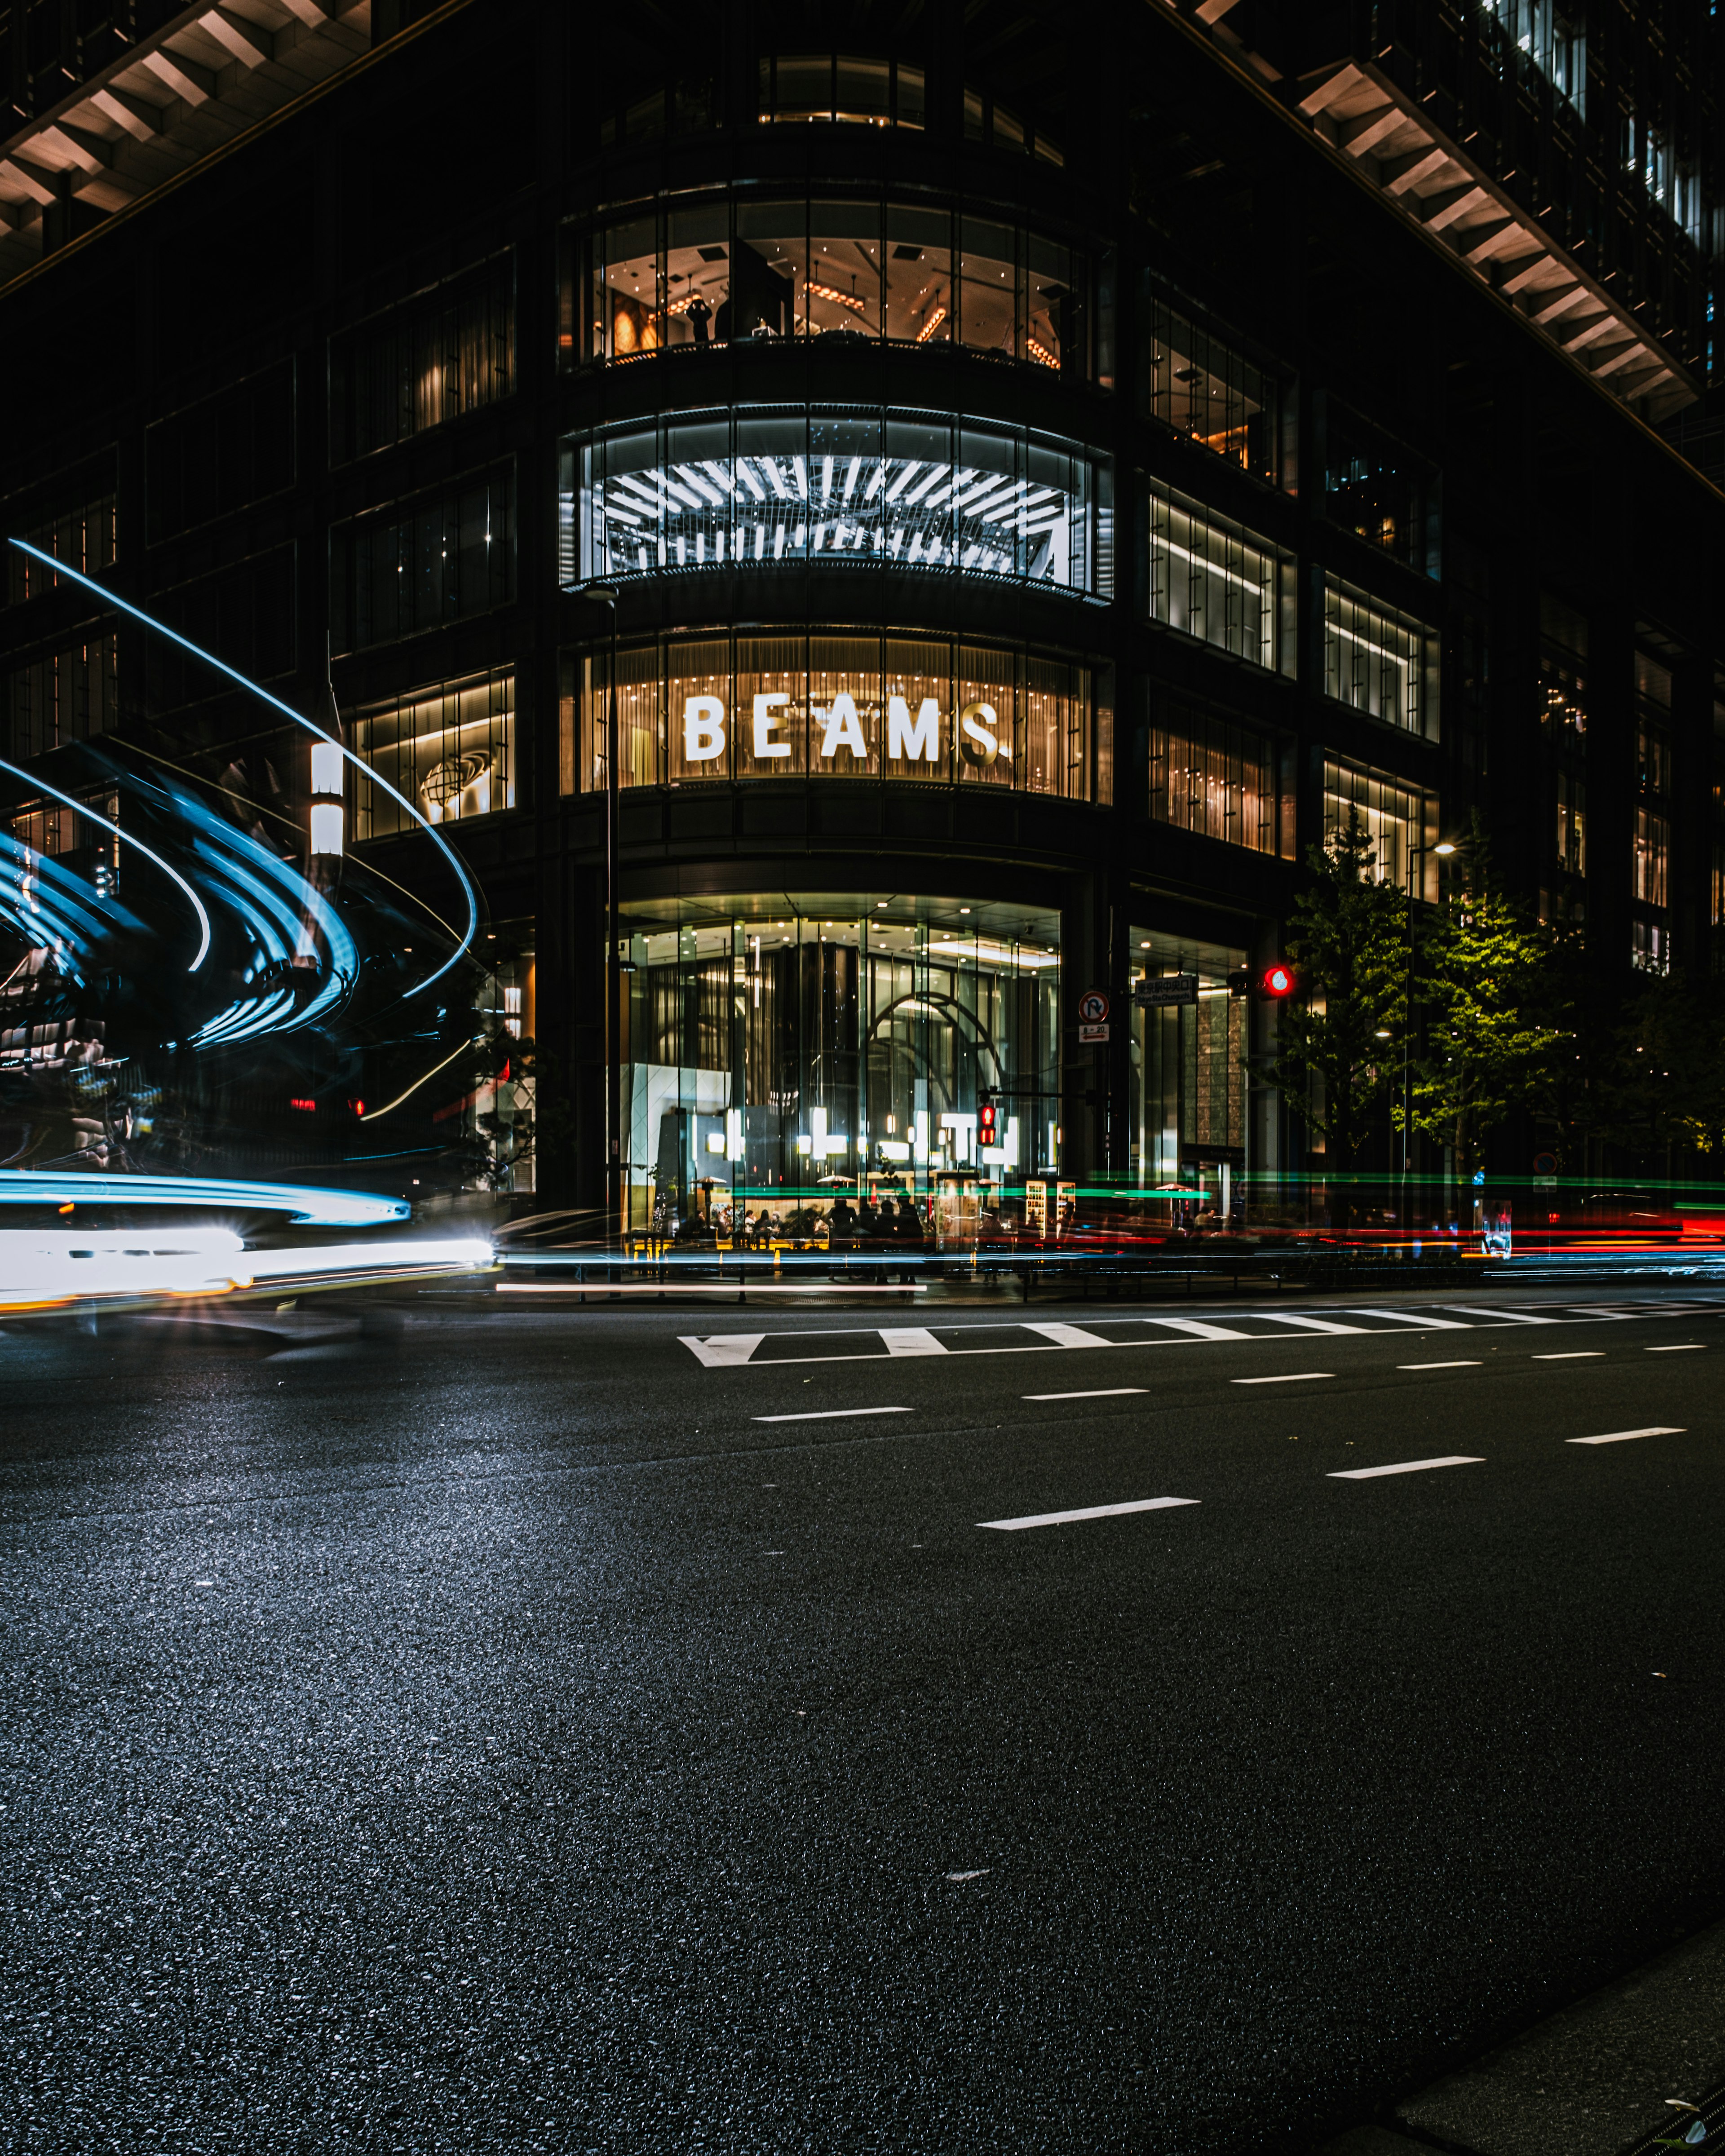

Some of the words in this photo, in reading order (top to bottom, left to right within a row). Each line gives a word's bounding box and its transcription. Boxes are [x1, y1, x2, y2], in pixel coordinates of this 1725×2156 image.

[685, 692, 998, 767] BEAMS
[1138, 980, 1188, 994] 東京駅中央口
